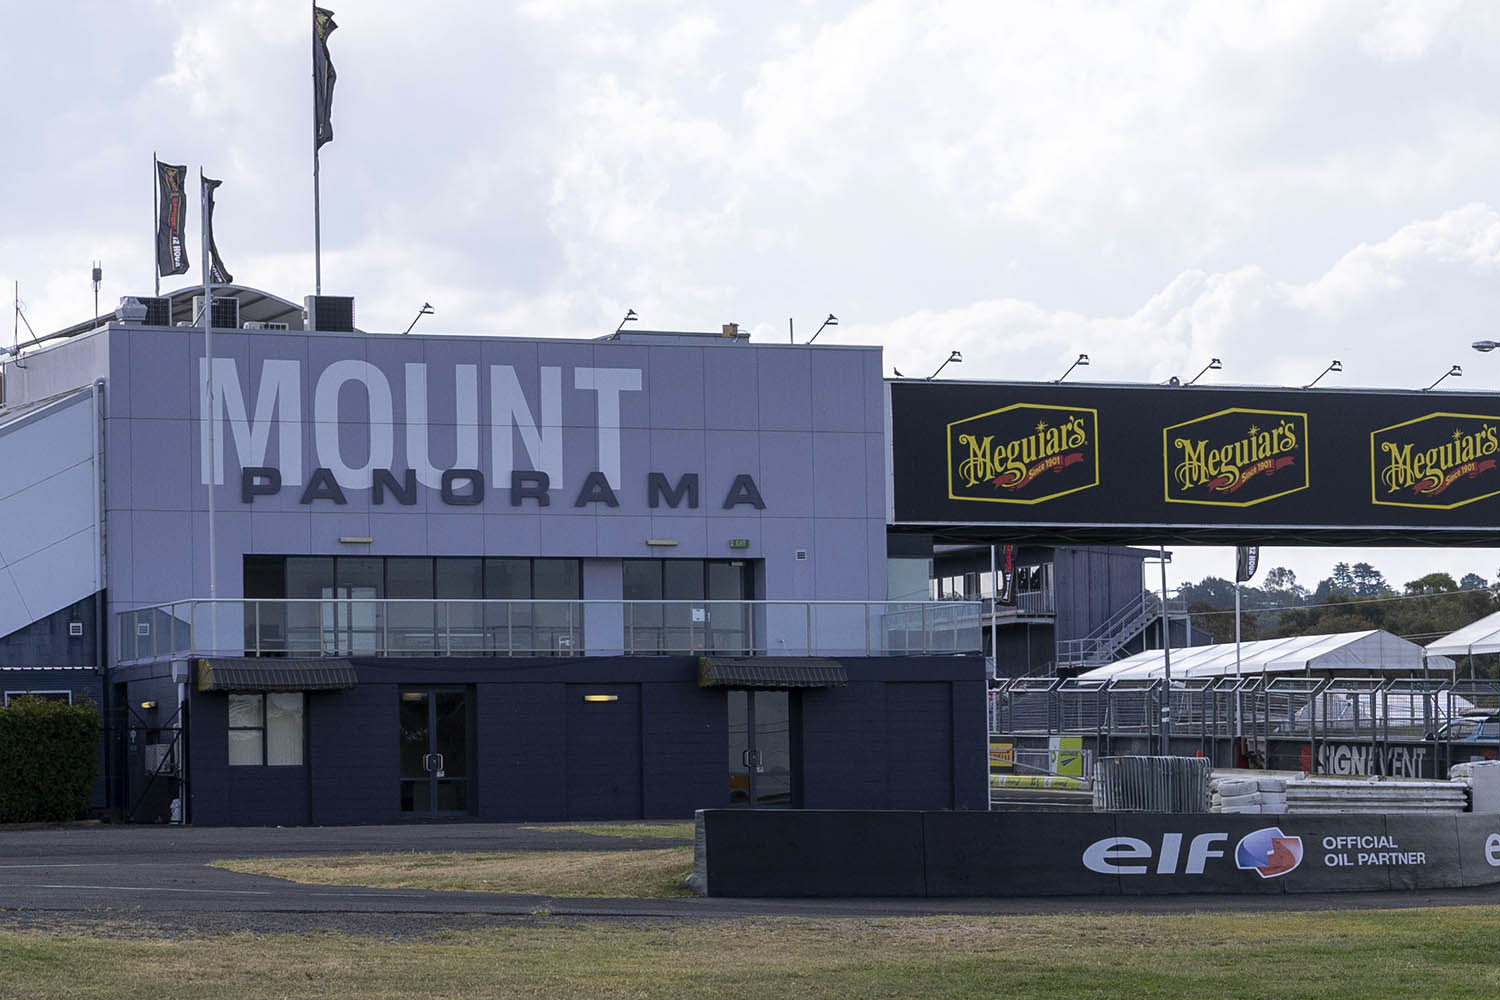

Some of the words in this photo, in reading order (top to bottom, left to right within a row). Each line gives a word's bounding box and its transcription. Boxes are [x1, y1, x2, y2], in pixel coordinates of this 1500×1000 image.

[200, 357, 642, 490] MOUNT
[958, 416, 1086, 487] Meguiar's
[1175, 419, 1297, 490] Meguiar's
[1257, 460, 1272, 472] 1901
[1381, 424, 1498, 494] Meguiar's
[241, 467, 767, 510] PANORAMA
[1082, 832, 1229, 875] elf
[1322, 835, 1399, 850] OFFICIAL
[1324, 853, 1355, 867] OIL
[1358, 851, 1426, 866] PARTNER
